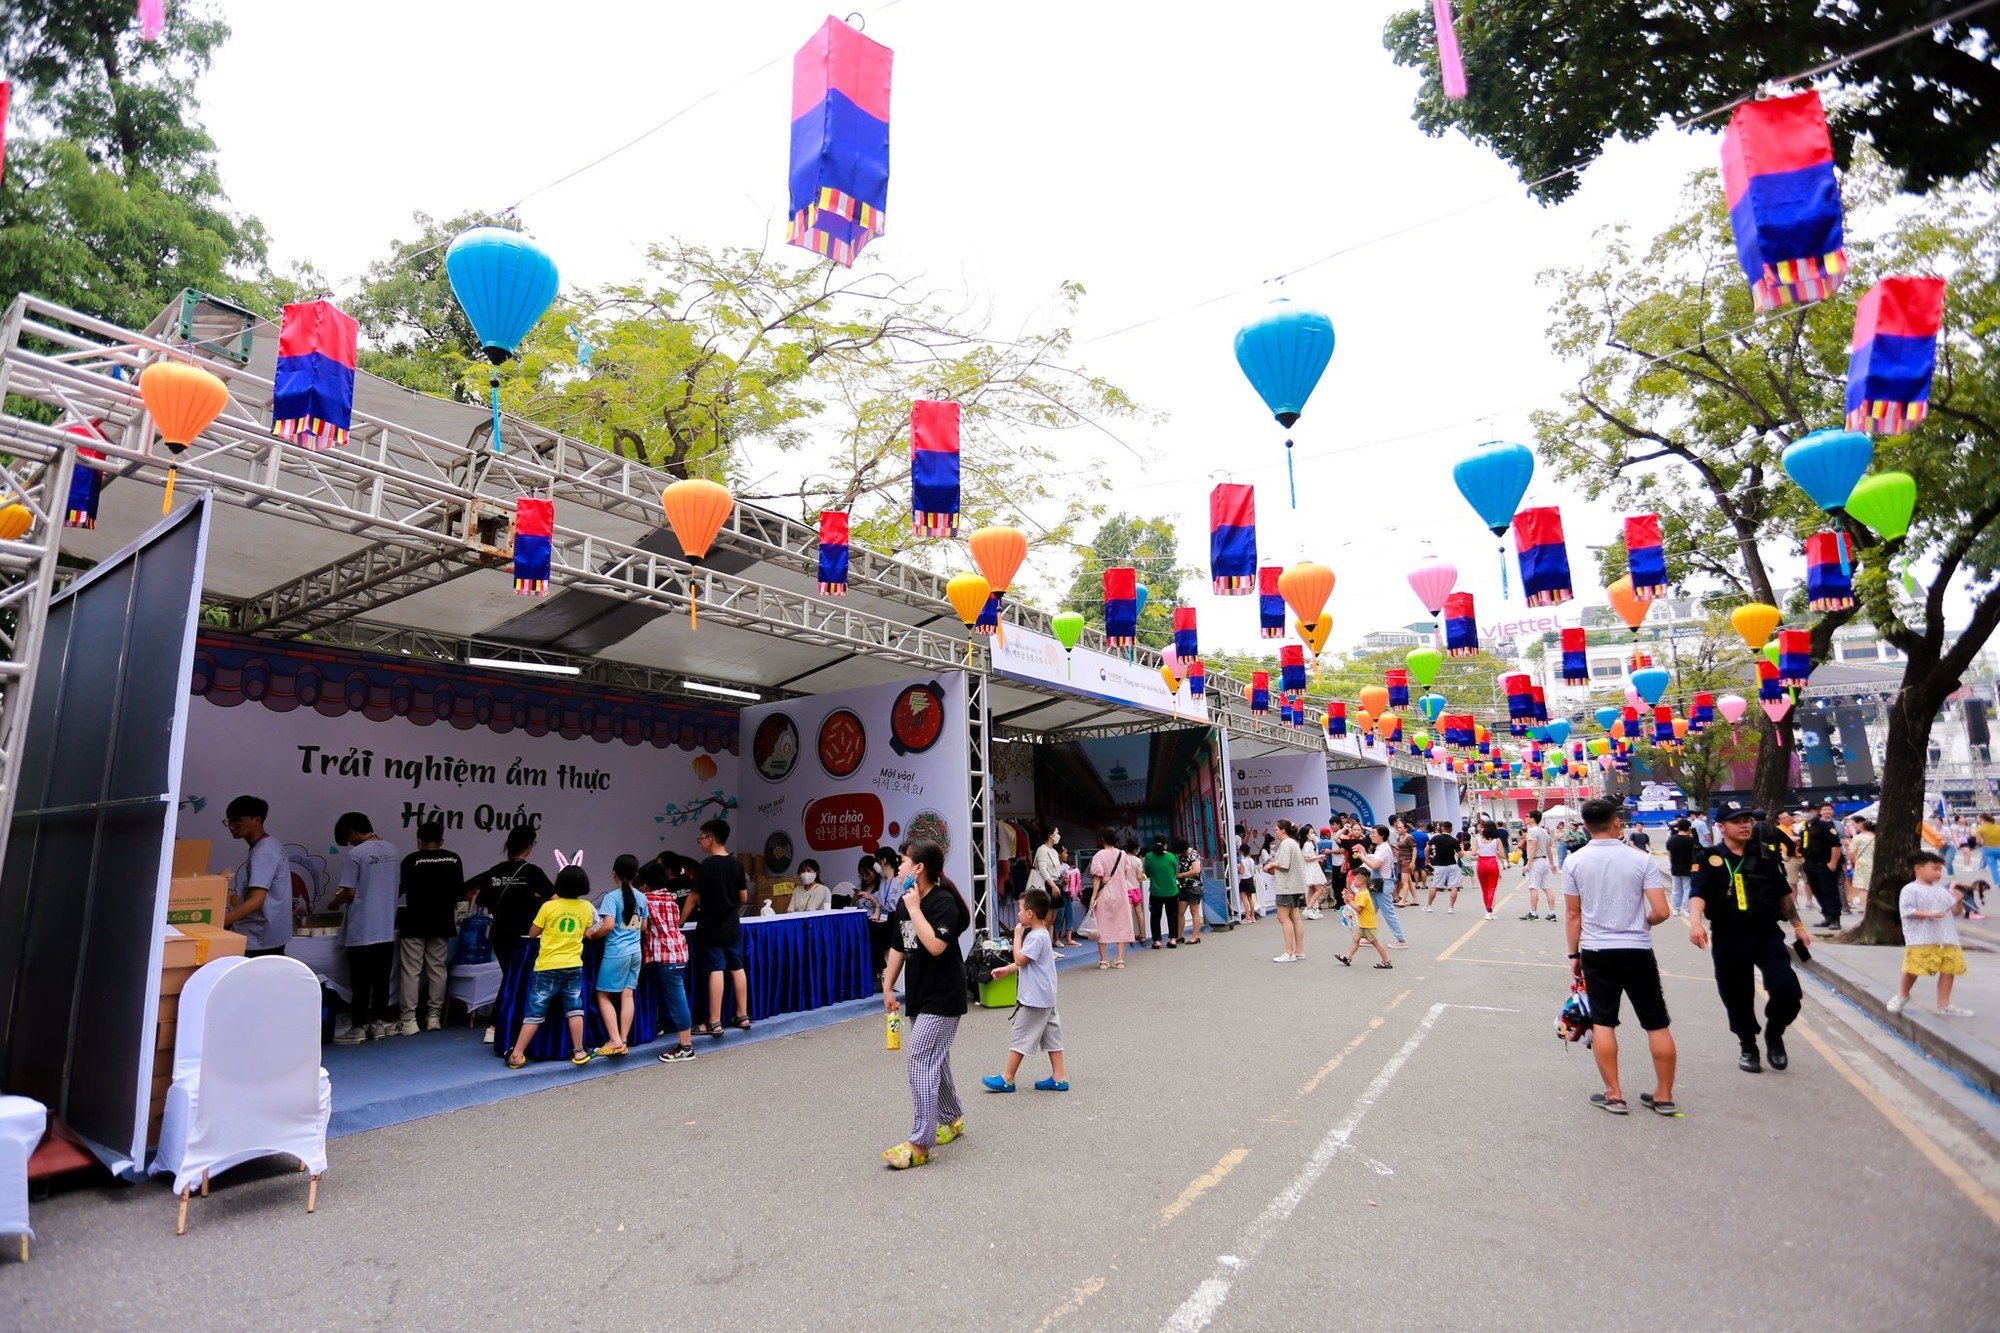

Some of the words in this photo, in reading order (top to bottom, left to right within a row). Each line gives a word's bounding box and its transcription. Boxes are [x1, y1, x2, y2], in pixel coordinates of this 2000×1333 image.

[1482, 615, 1562, 638] viettel
[297, 745, 374, 778] Trải
[384, 755, 496, 788] nghiệm
[506, 756, 547, 786] ẩm
[557, 764, 610, 792] thực
[880, 768, 897, 778] Mời
[898, 770, 915, 781] vào!
[872, 777, 890, 790] 어서
[892, 781, 923, 795] 오세요!
[401, 802, 463, 830] Hàn
[474, 802, 542, 833] Quốc
[820, 812, 837, 824] Xin
[839, 809, 864, 823] chào
[815, 824, 873, 841] 안녕하세요
